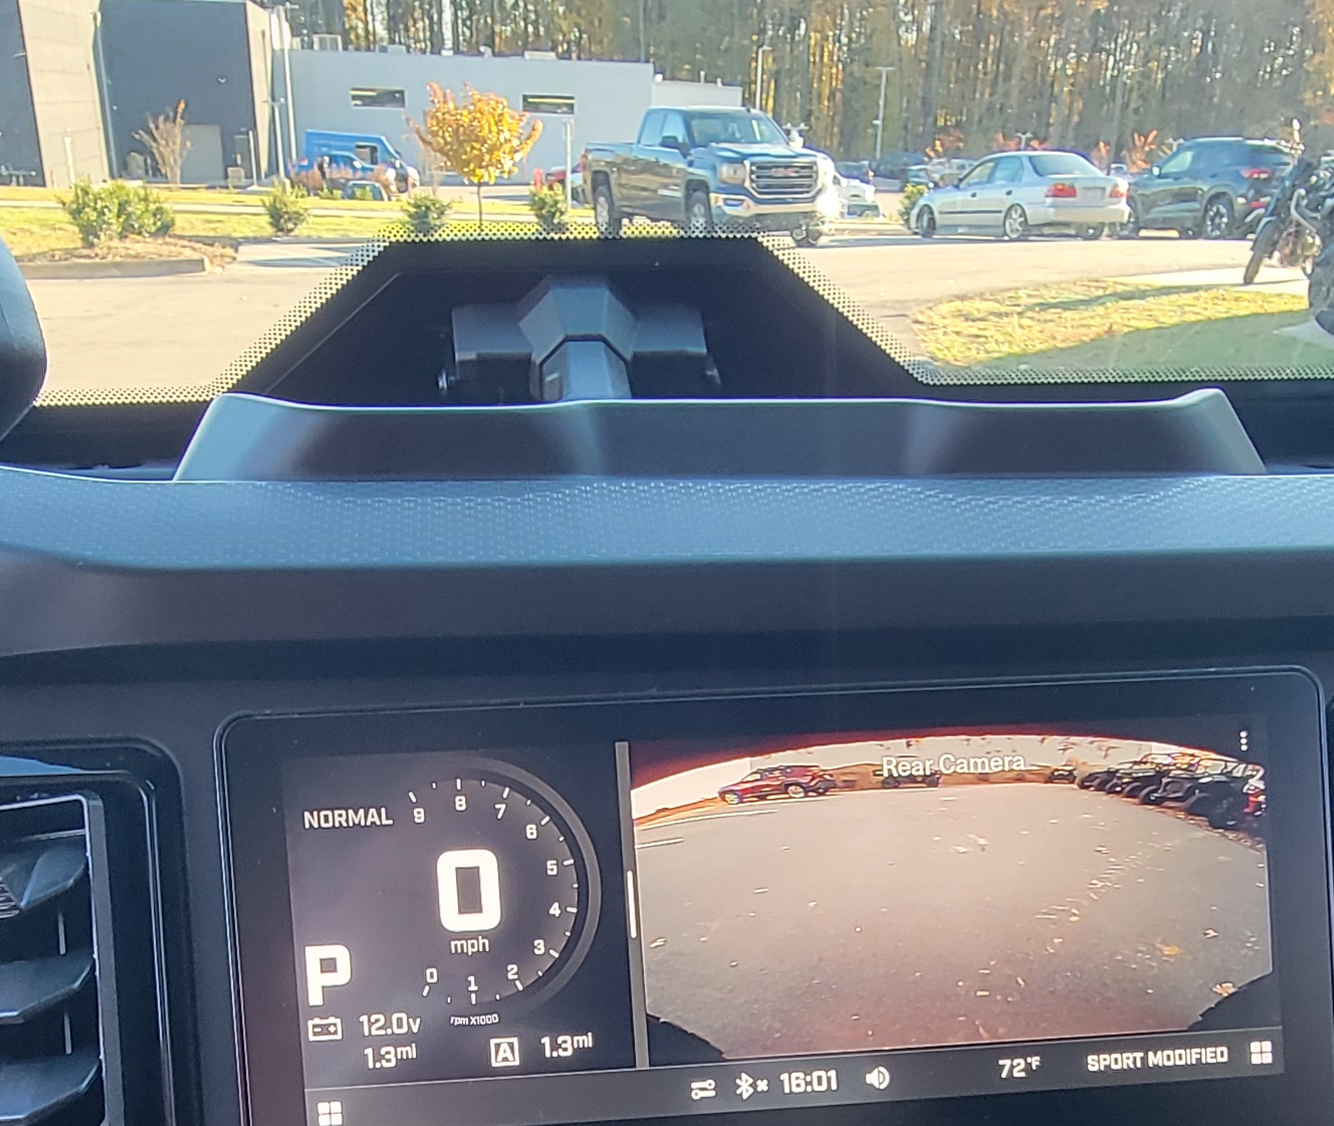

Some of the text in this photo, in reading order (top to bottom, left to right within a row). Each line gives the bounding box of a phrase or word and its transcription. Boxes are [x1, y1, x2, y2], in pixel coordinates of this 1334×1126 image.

[882, 753, 1025, 777] Rear Camera
[454, 796, 467, 811] 8
[495, 804, 507, 819] 7
[303, 807, 394, 830] NORMAL
[413, 808, 426, 824] 9
[525, 824, 538, 840] 6
[546, 860, 558, 876] 5
[435, 849, 502, 932] 0
[548, 902, 562, 918] 4
[450, 935, 491, 957] mph
[533, 940, 546, 955] 3
[304, 944, 352, 1006] P
[426, 968, 438, 984] 0
[506, 964, 519, 980] 2
[467, 976, 478, 990] 1
[359, 1012, 421, 1036] 12.0v
[1087, 1046, 1229, 1071] SPORT MODIFIED
[779, 1068, 839, 1094] 16:01
